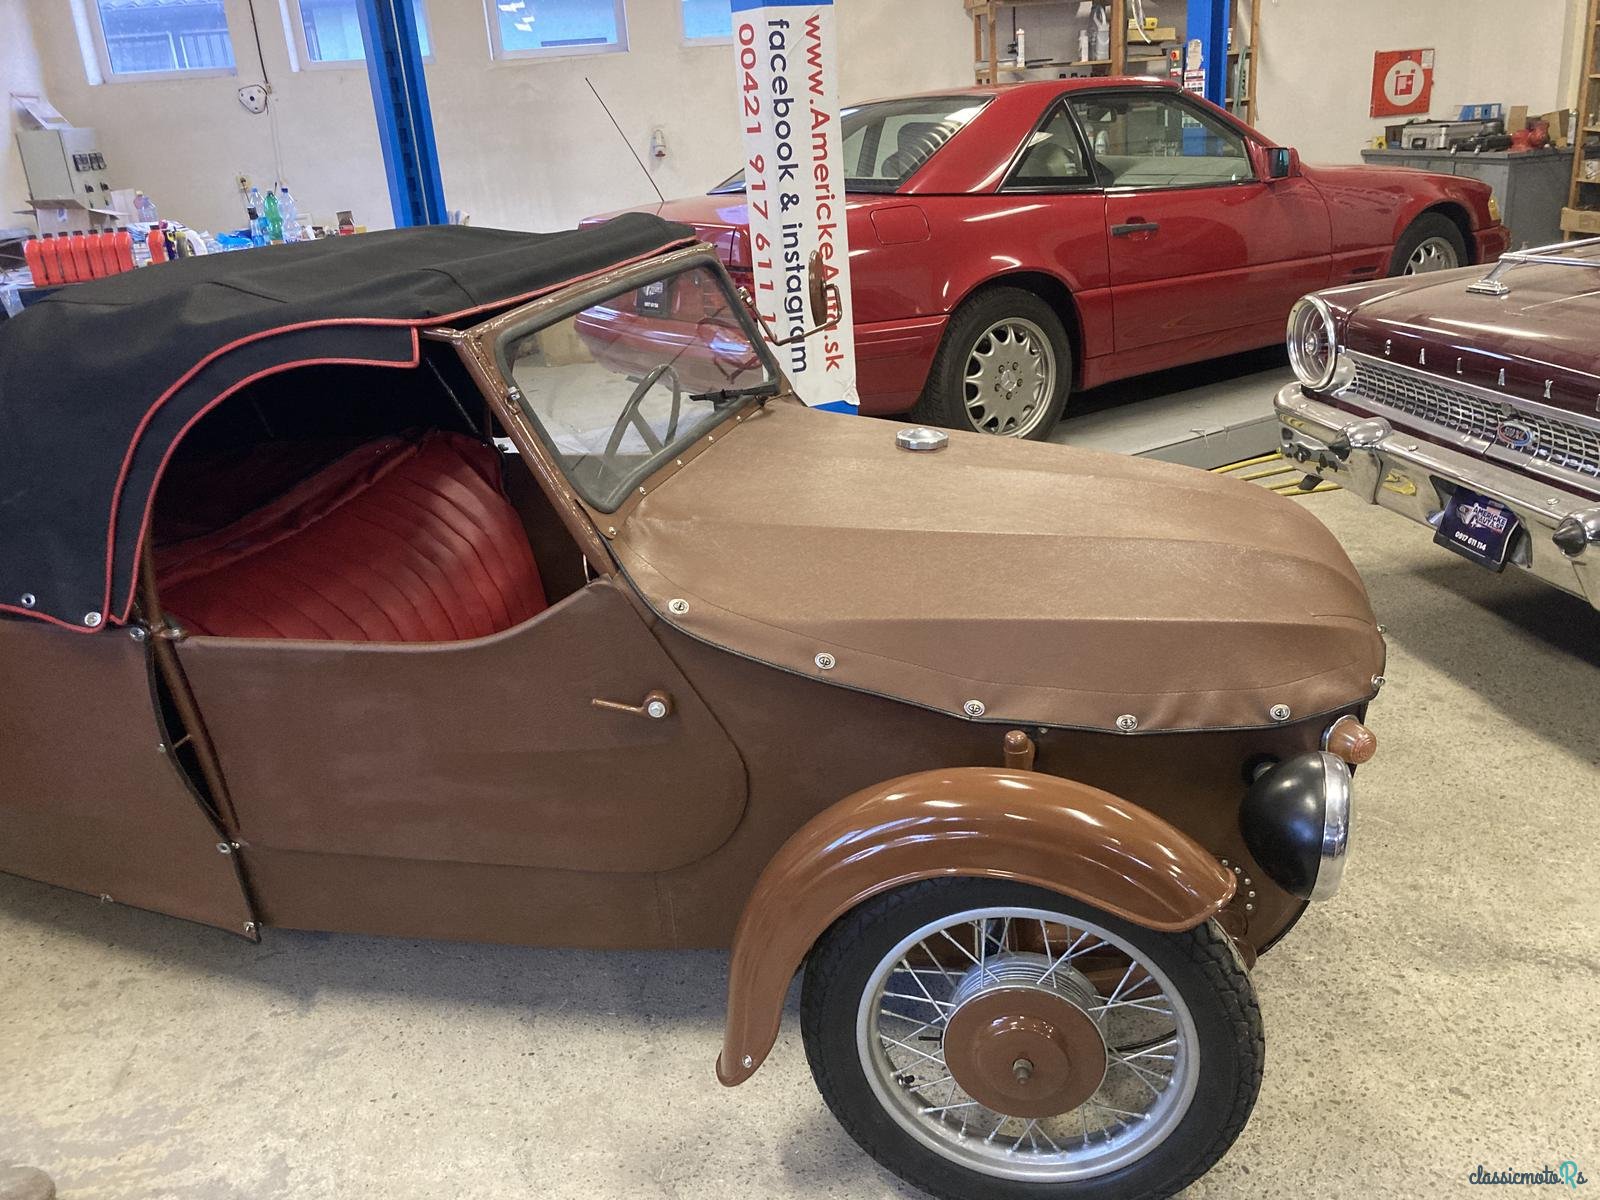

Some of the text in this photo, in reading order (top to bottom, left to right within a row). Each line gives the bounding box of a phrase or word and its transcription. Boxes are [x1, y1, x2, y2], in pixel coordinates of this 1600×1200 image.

[738, 23, 762, 134] 00421
[749, 154, 769, 220] 917
[768, 19, 807, 373] facebook & instagram
[755, 232, 774, 291] 611
